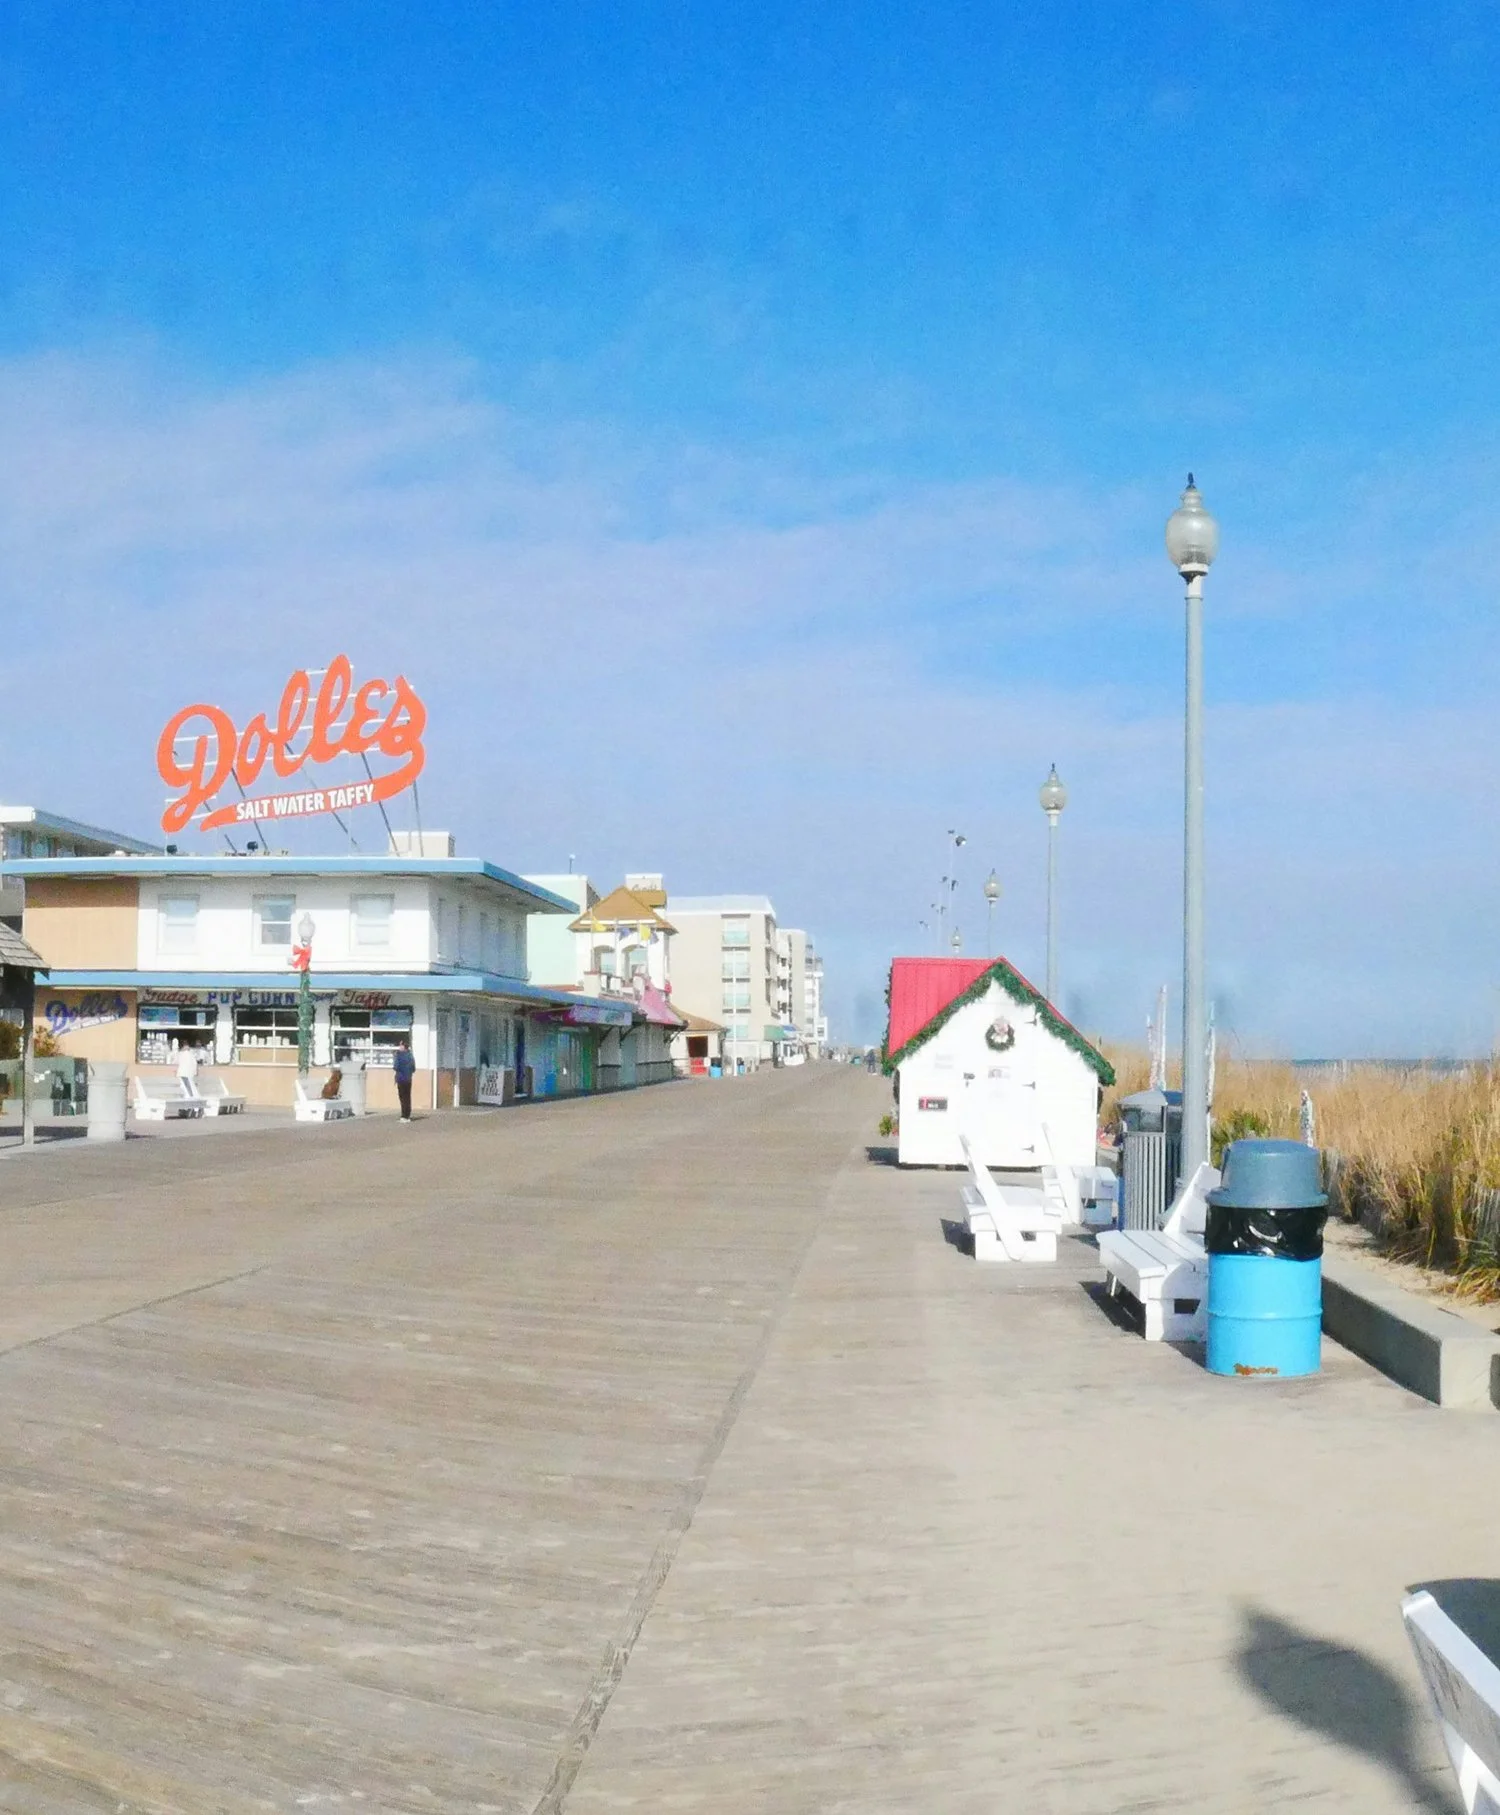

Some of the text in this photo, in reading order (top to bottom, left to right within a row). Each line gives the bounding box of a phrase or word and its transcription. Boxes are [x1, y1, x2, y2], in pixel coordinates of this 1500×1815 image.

[236, 784, 375, 821] SALT WATER TAFFY
[341, 989, 391, 1009] Taffy
